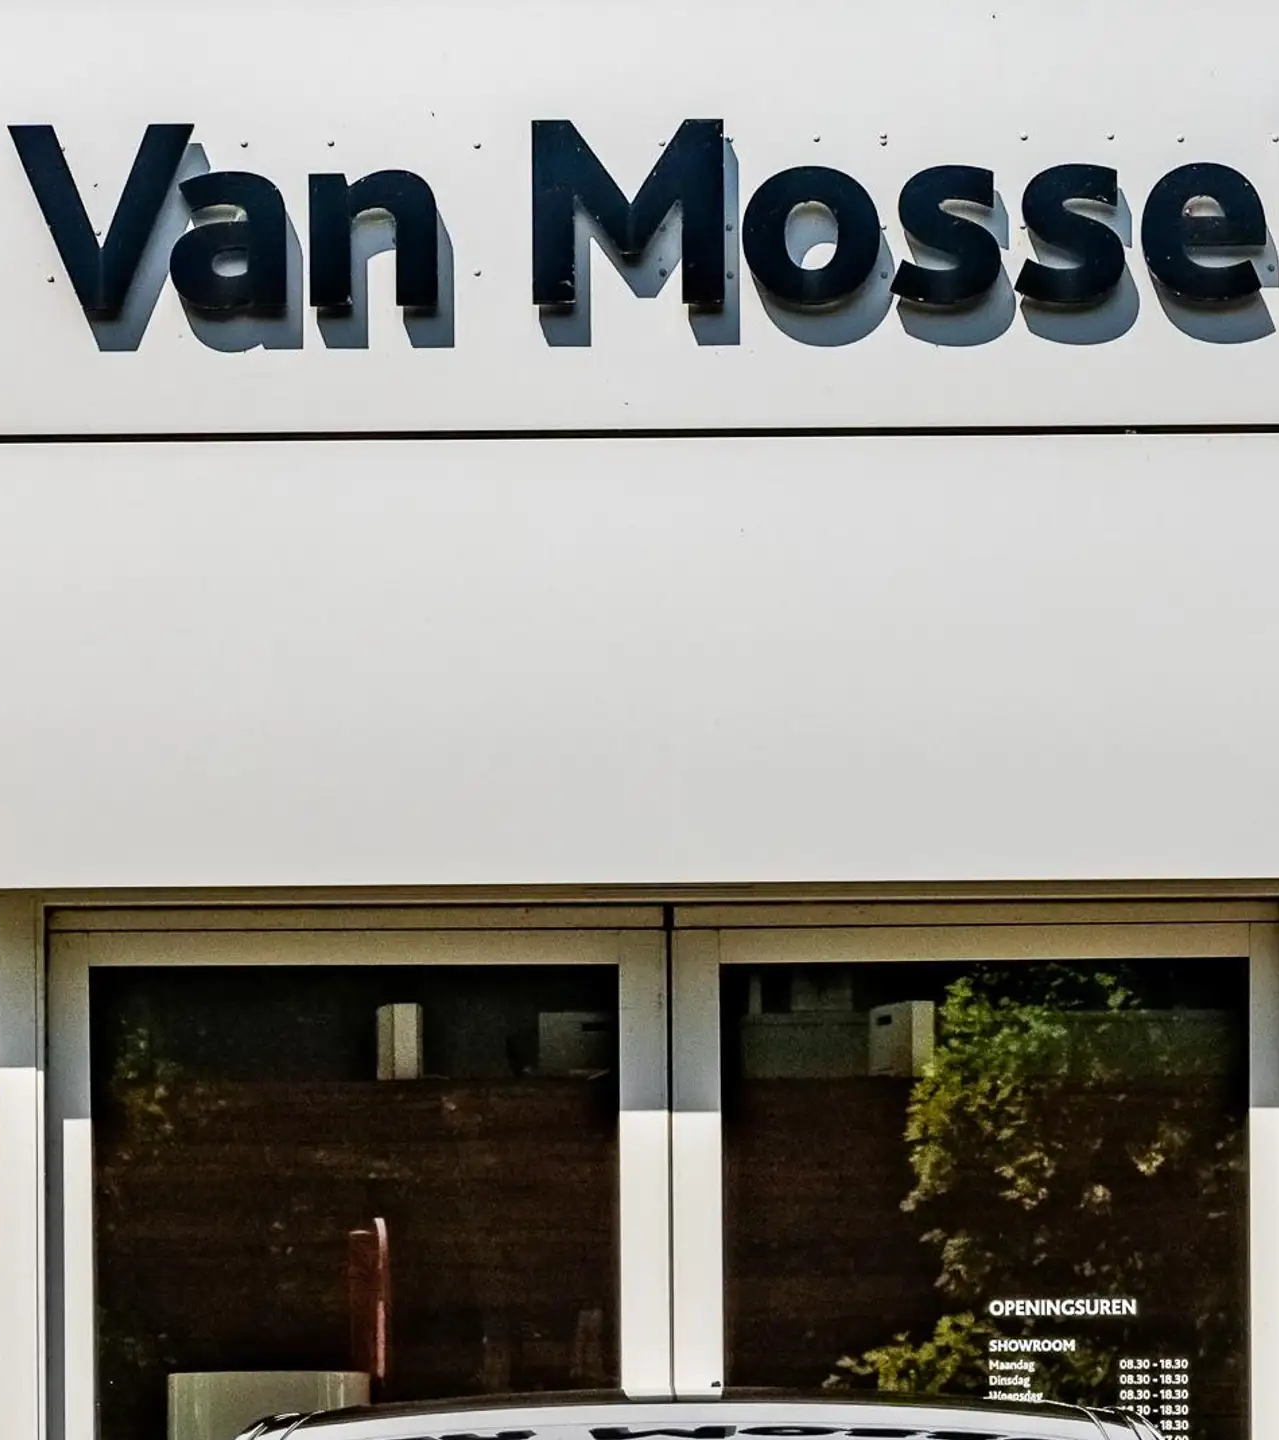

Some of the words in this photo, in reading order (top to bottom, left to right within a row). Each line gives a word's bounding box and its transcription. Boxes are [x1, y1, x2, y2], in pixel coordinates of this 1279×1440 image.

[6, 122, 442, 312] Van
[988, 1298, 1137, 1317] OPENINGSUREN
[988, 1338, 1076, 1353] SHOWROOM
[988, 1359, 1036, 1373] Maandag
[1119, 1359, 1151, 1370] 08.30
[1159, 1359, 1189, 1370] 18.30
[988, 1375, 1031, 1388] Dinsdag
[1119, 1374, 1151, 1385] 08.30
[1159, 1374, 1189, 1385] 18.30
[1119, 1389, 1151, 1400] 08.30
[1159, 1389, 1189, 1400] 18.30
[1159, 1404, 1189, 1415] 18.30
[1159, 1419, 1189, 1430] 18.30
